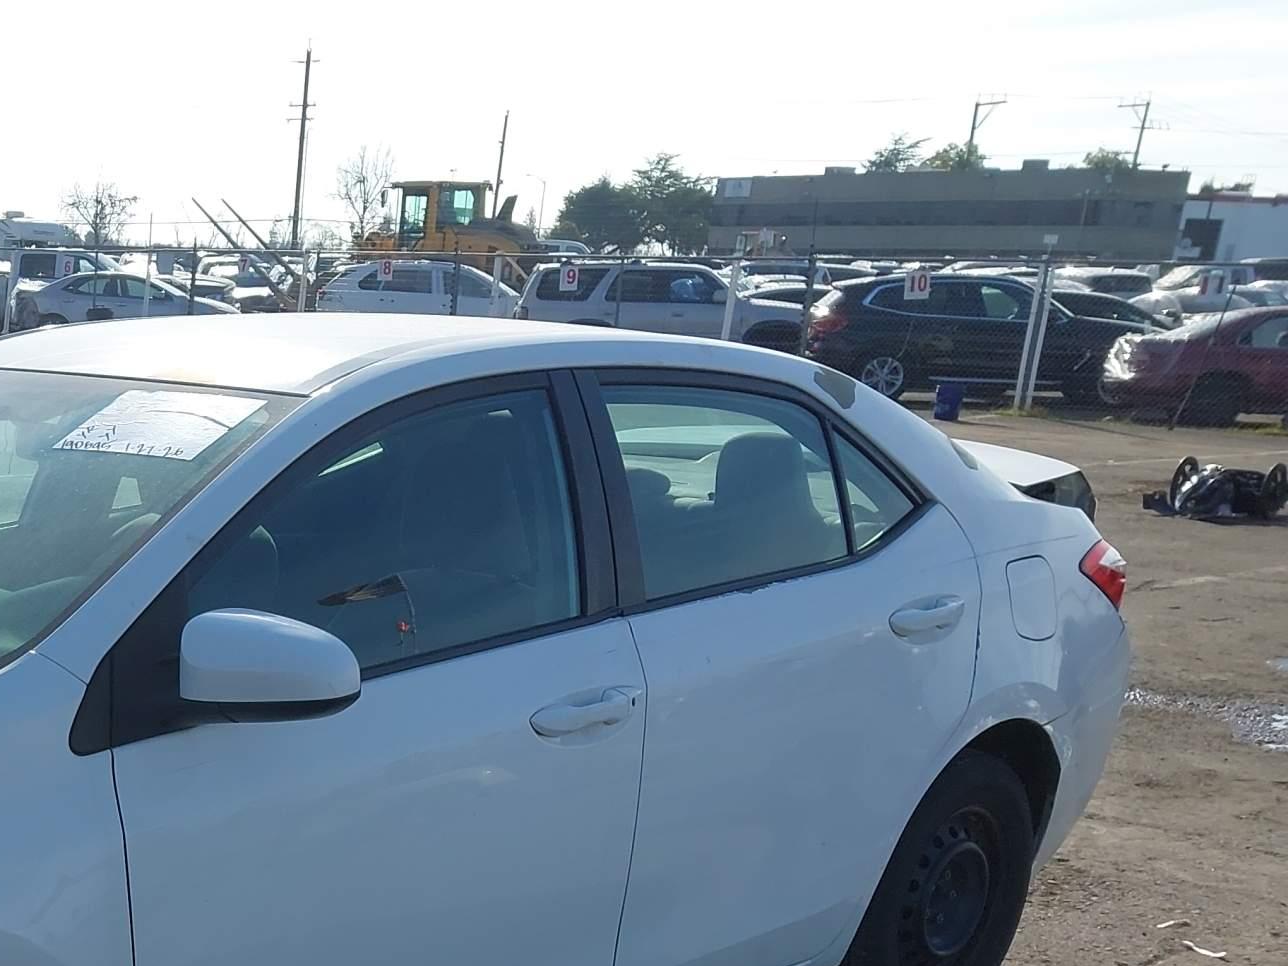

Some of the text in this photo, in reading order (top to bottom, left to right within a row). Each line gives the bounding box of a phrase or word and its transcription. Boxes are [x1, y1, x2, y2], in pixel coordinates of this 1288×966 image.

[64, 260, 71, 274] 6
[240, 259, 248, 272] 7
[383, 260, 391, 275] 8
[567, 268, 576, 285] 9
[910, 274, 928, 293] 10
